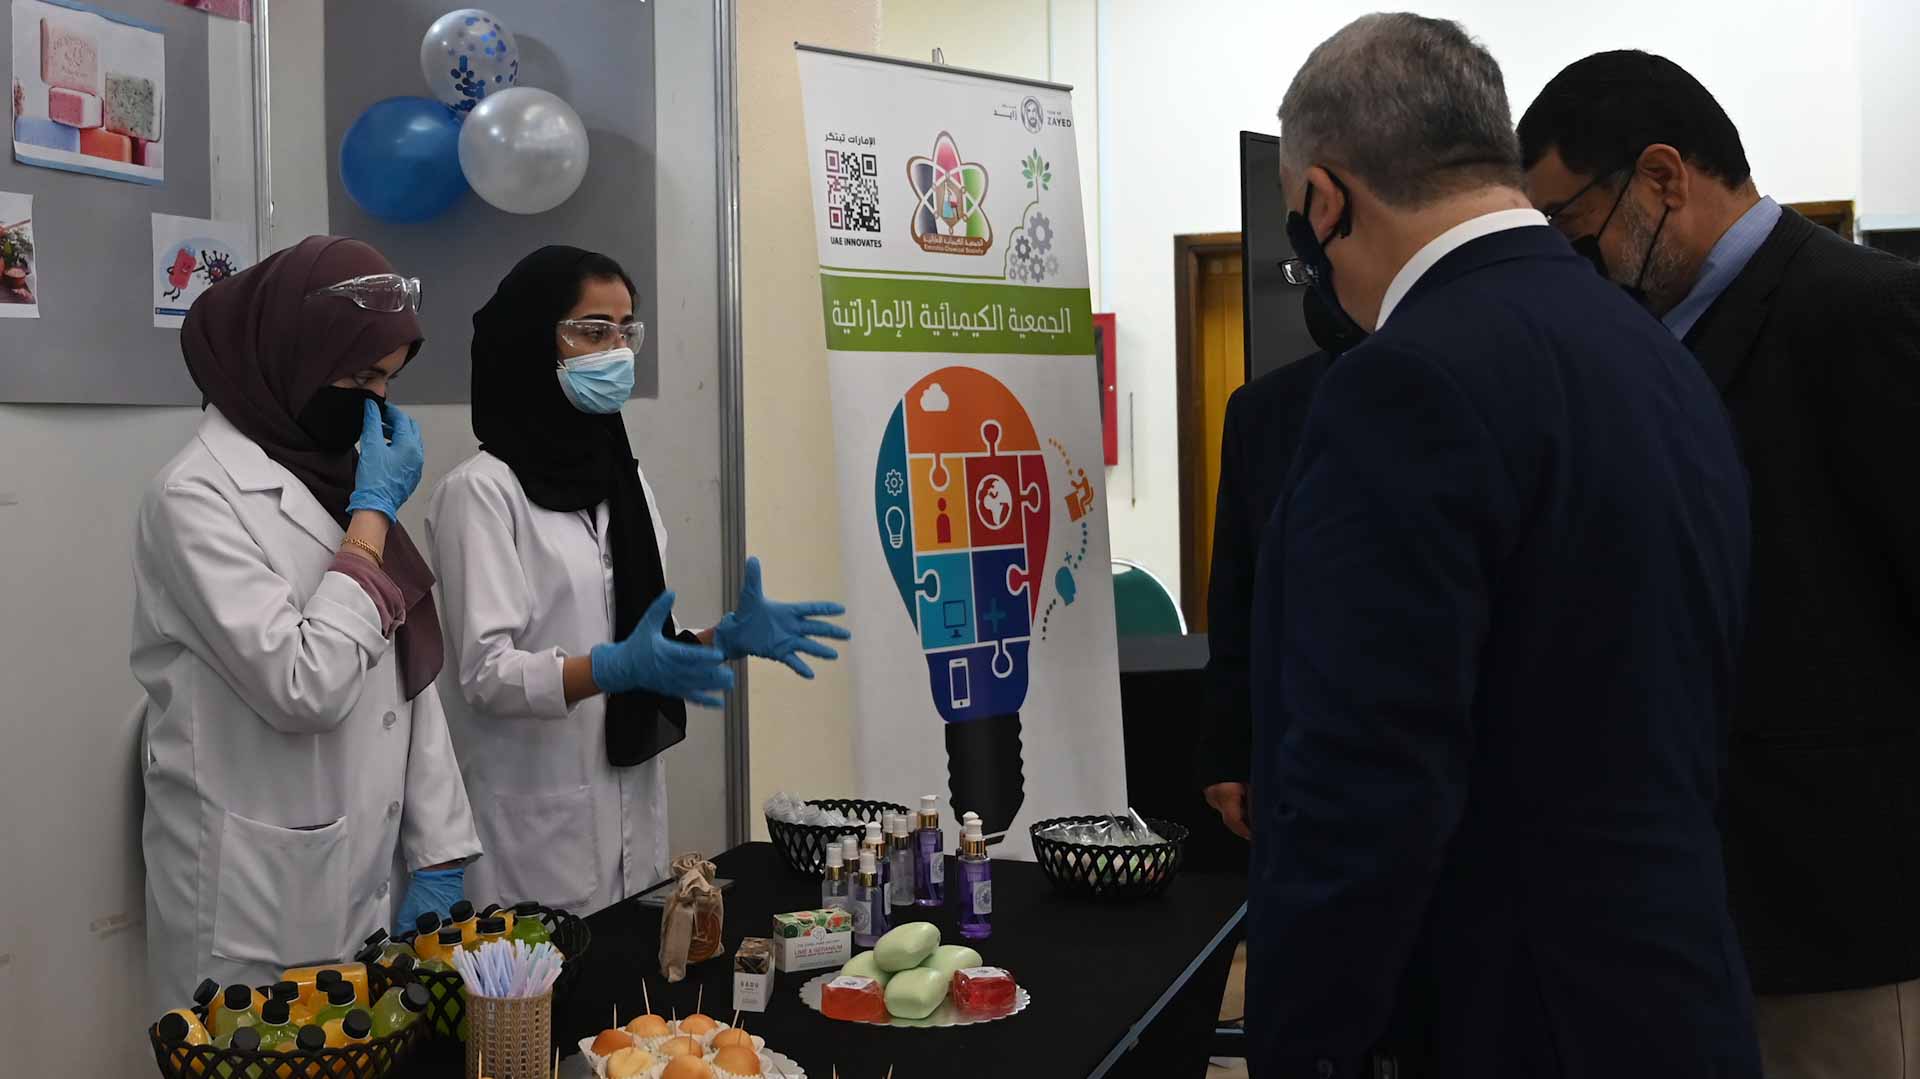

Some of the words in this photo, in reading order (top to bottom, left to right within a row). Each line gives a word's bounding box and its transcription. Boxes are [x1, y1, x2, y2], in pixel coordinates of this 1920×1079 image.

[1047, 116, 1072, 128] ZAYED
[825, 132, 846, 144] تبتكر
[830, 236, 843, 246] UAE
[844, 238, 882, 248] INNOVATES
[831, 298, 914, 338] الإماراتية
[919, 301, 1004, 338] الكيميائية
[1008, 306, 1071, 340] الجمعية
